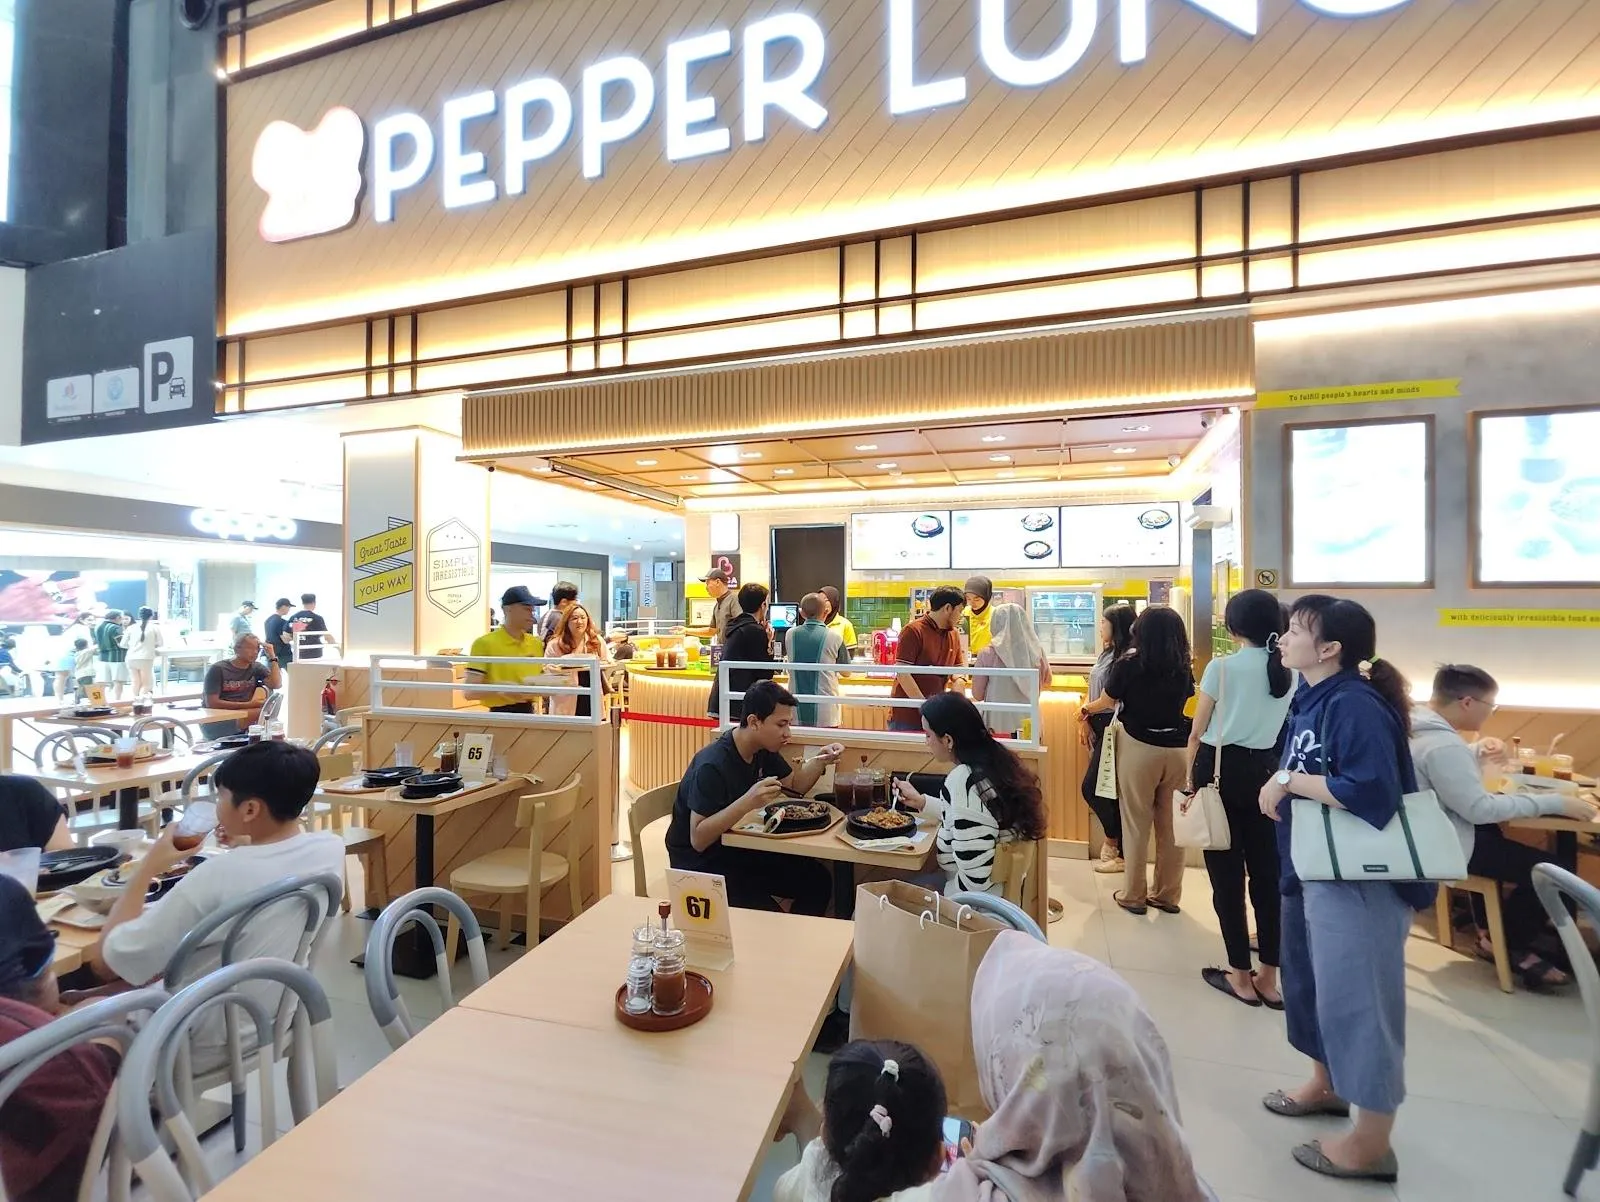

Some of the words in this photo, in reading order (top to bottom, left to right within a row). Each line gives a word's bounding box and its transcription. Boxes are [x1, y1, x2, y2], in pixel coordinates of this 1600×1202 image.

[371, 11, 829, 224] PEPPER
[150, 351, 175, 402] P
[1321, 390, 1352, 400] people's
[1353, 388, 1378, 397] hearts
[1380, 387, 1394, 395] and
[1396, 386, 1421, 394] minds
[359, 543, 384, 563] Great
[384, 535, 408, 552] Taste
[433, 554, 476, 570] SIMPLY
[359, 581, 385, 597] YOUR
[387, 573, 408, 589] WAY
[467, 747, 483, 760] 65
[685, 895, 711, 920] 67
